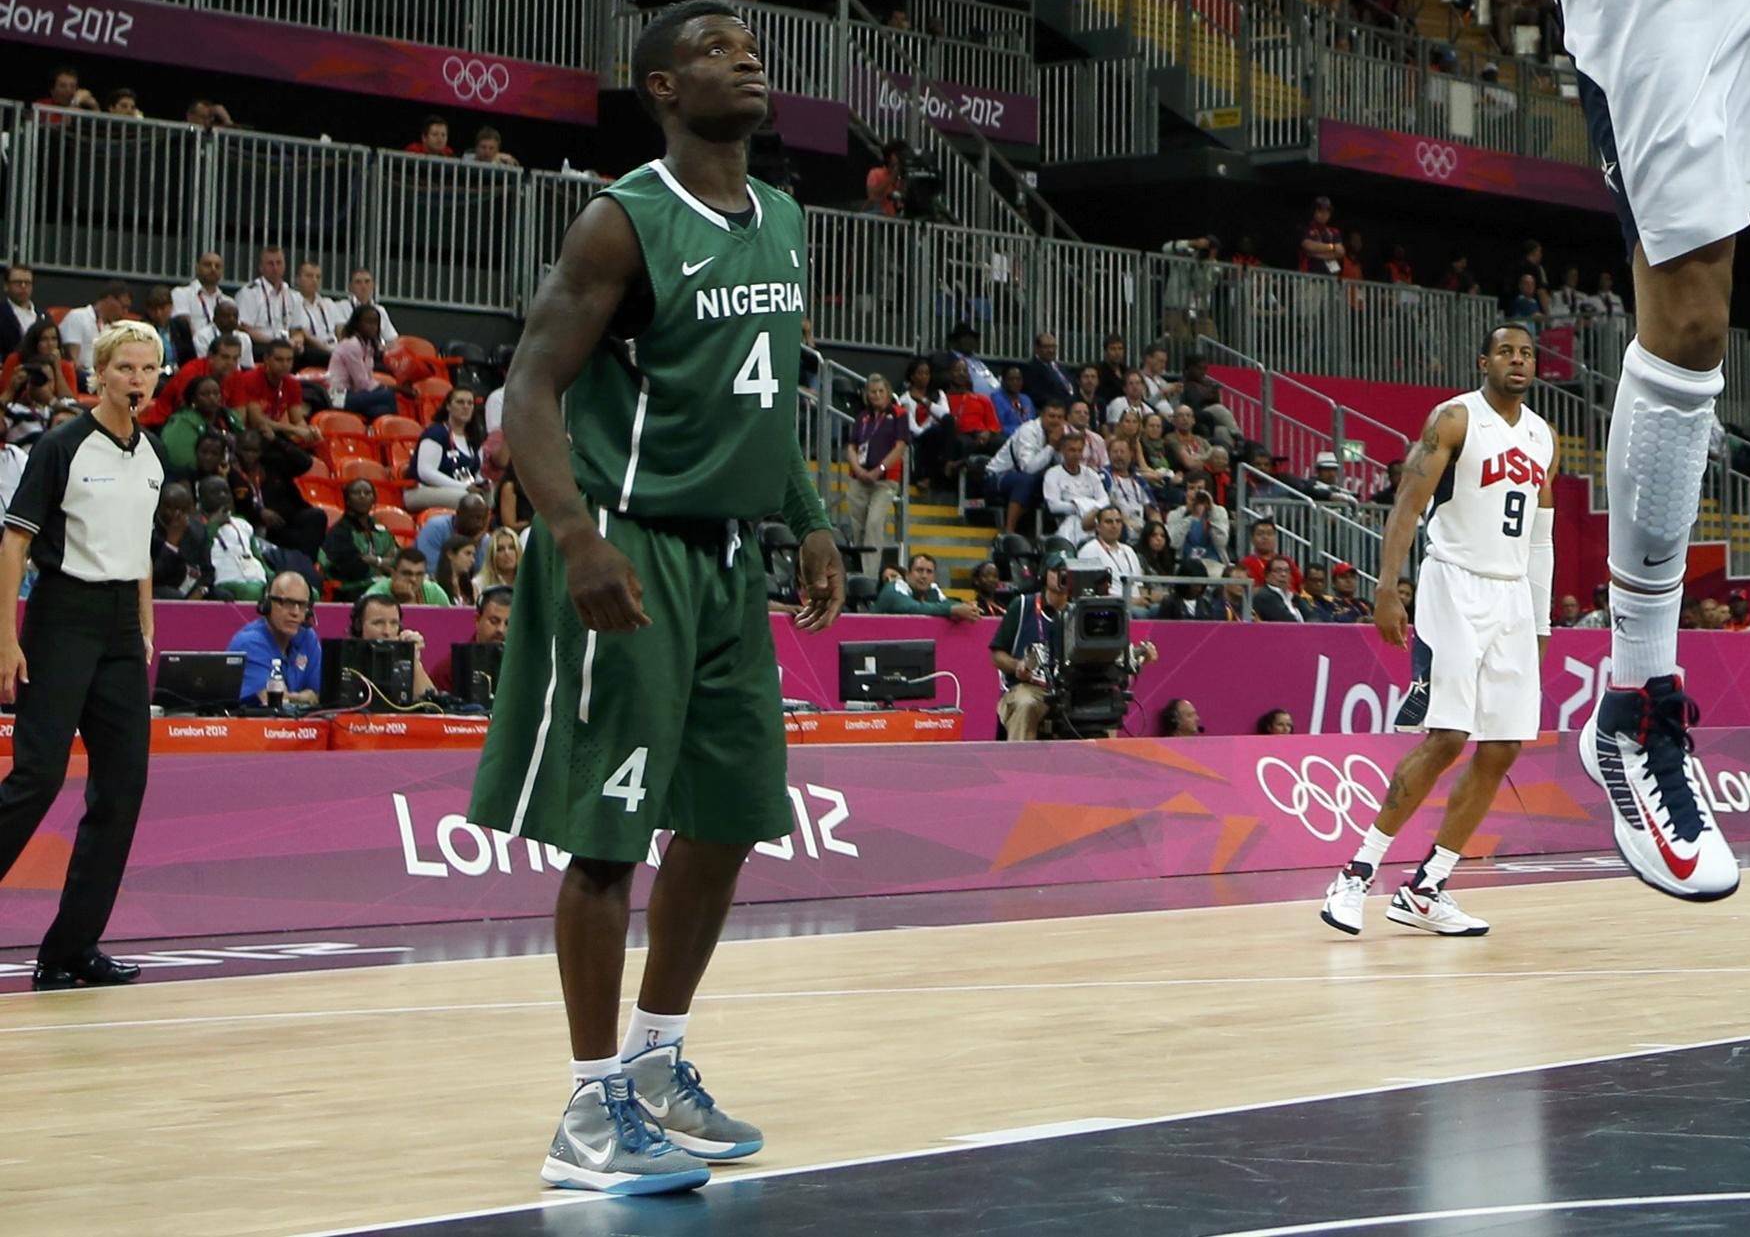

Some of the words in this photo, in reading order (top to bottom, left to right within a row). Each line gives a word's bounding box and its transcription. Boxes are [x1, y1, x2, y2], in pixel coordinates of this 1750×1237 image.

[62, 4, 134, 46] 2012
[696, 282, 804, 320] NIGERIA
[733, 331, 779, 409] 4
[1480, 446, 1545, 488] USA
[1502, 490, 1526, 538] 9
[168, 726, 204, 737] London
[206, 726, 228, 737] 2012
[264, 727, 296, 739] London
[602, 746, 648, 813] 4
